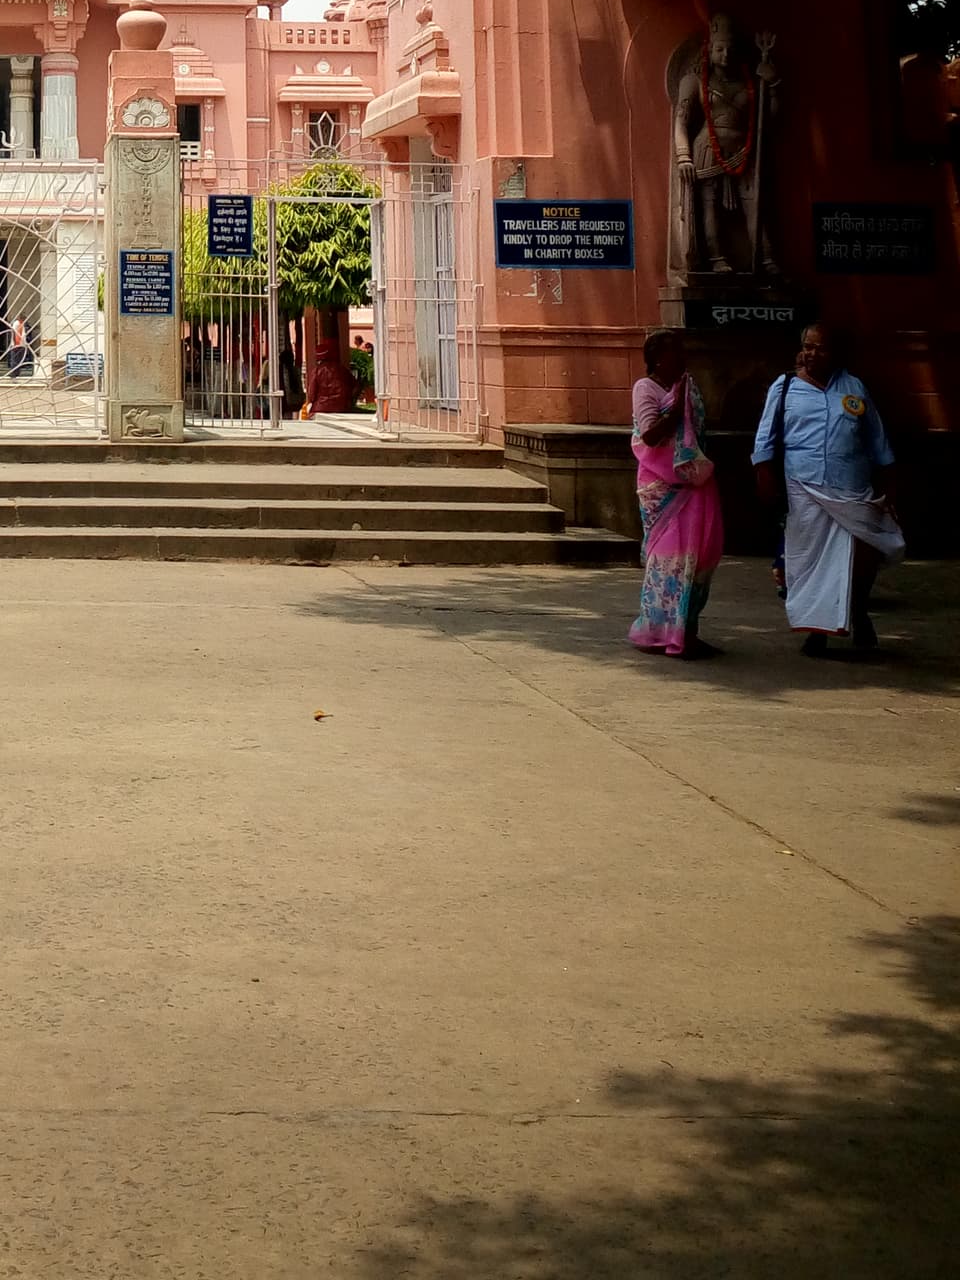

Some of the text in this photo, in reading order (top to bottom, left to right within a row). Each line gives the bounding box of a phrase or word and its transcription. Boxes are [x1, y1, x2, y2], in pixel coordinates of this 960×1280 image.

[542, 207, 581, 217] NOTICE
[503, 220, 625, 232] TRAVELLERS ARE REQUESTED
[503, 234, 625, 246] KINDLY TO DROP THE MONEY
[524, 248, 605, 259] IN CHARITY BOXES
[821, 238, 850, 258] भीतर
[149, 254, 169, 262] TEMPLE
[711, 306, 795, 324] द्वारपाल
